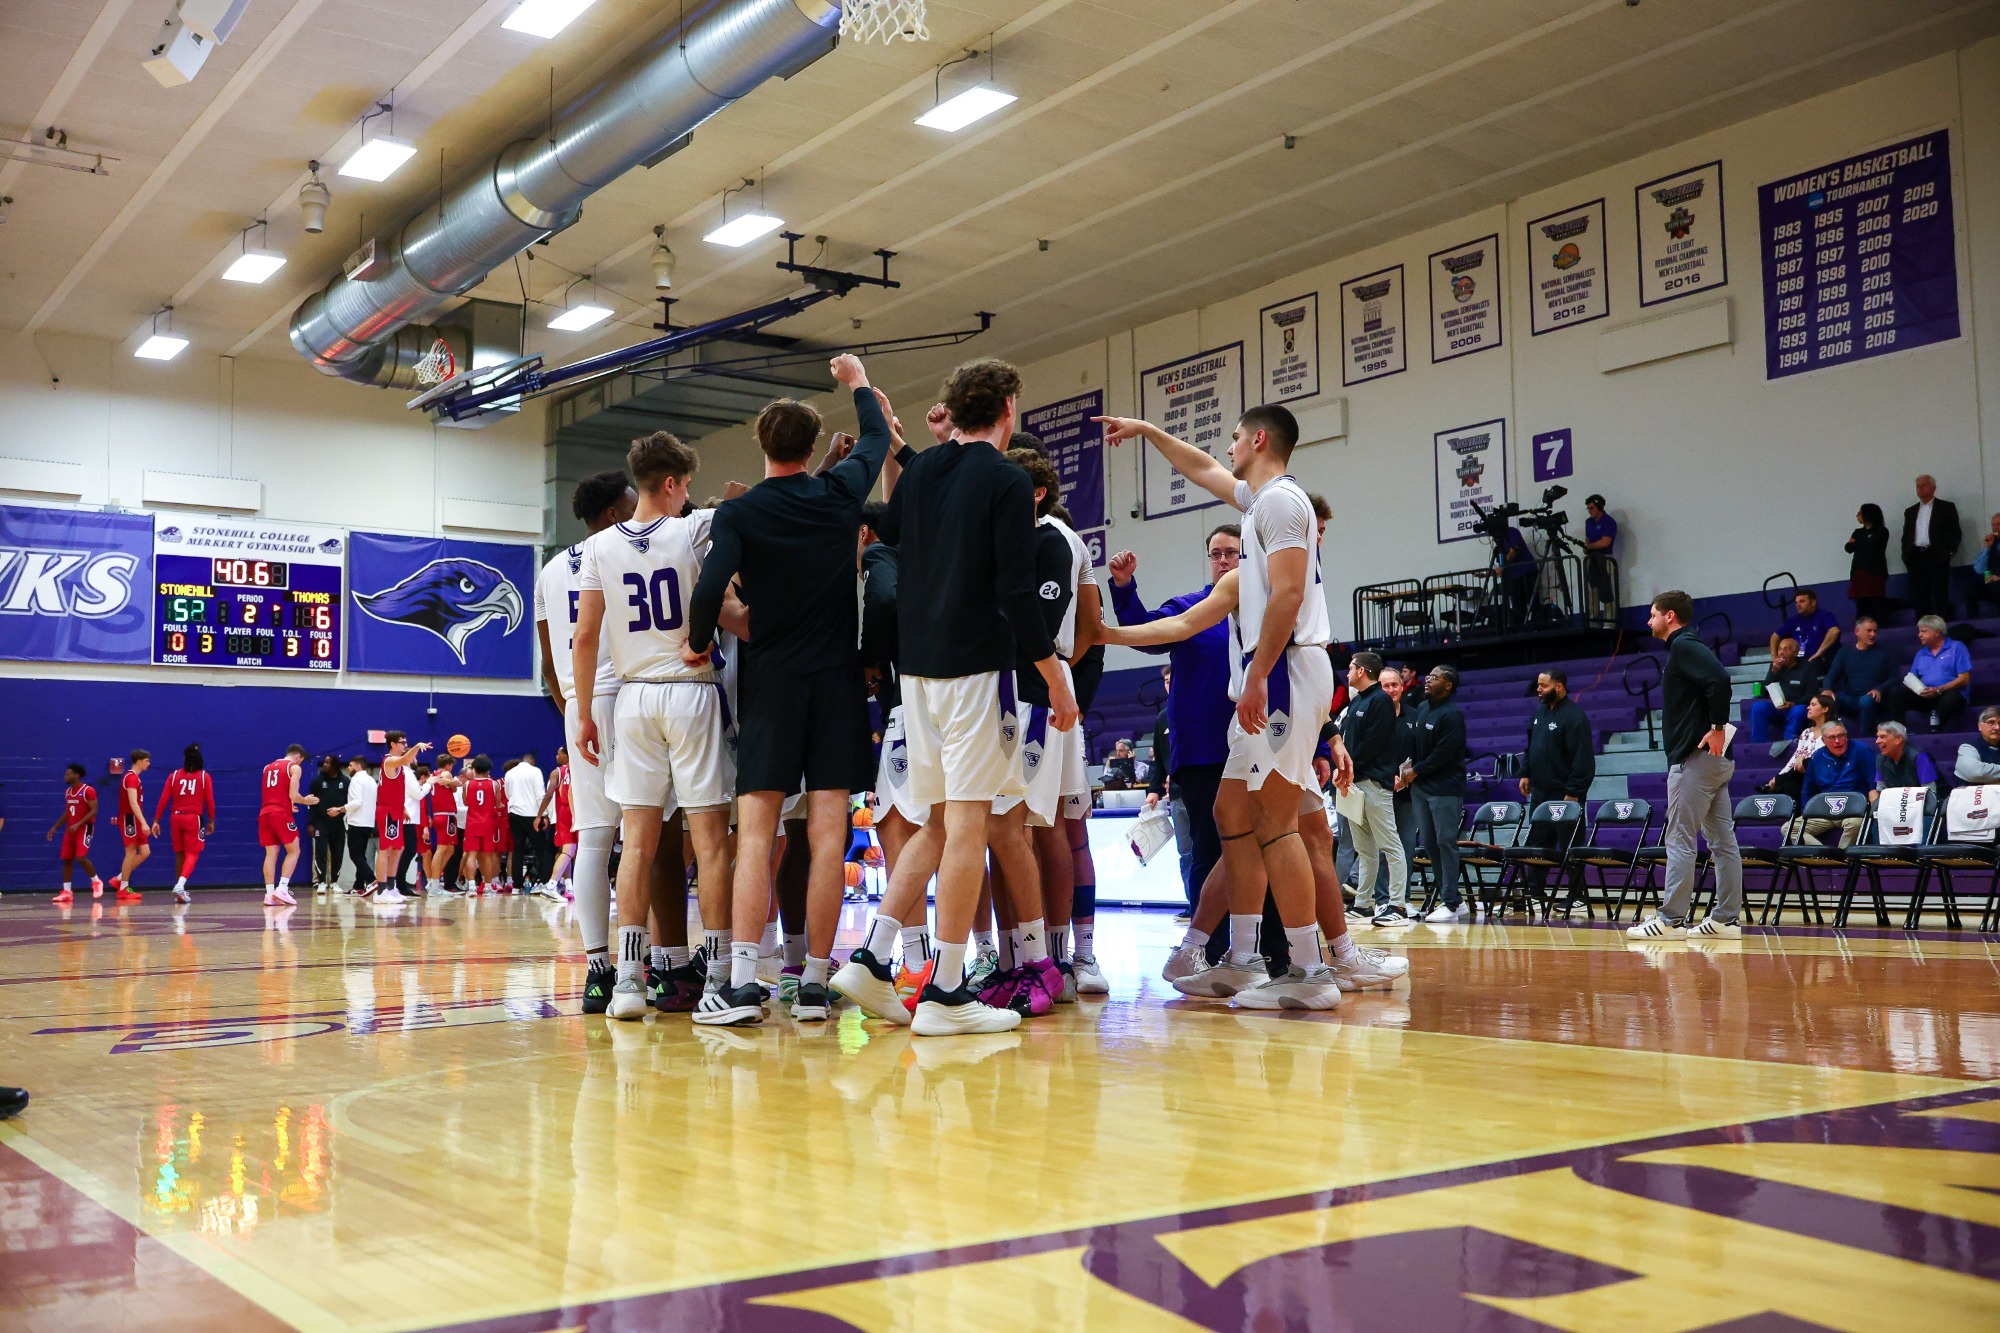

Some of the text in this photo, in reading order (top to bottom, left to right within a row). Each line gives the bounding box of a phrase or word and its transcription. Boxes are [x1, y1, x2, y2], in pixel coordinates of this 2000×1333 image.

[1774, 141, 1933, 203] WOMEN'S BASKETBALL
[1826, 172, 1895, 203] TOURNAMENT
[1904, 182, 1934, 203] 2019
[1857, 195, 1889, 217] 2007
[1903, 201, 1938, 223] 2020
[1814, 209, 1843, 229] 1995
[1857, 214, 1891, 236] 2008
[1774, 221, 1801, 240] 1983
[1815, 227, 1844, 247] 1996
[1775, 239, 1802, 258] 1985
[1858, 233, 1892, 255] 2009
[1655, 246, 1708, 268] REGIONAL CHAMPIONS
[1816, 246, 1844, 265] 1997
[1861, 253, 1890, 273] 2010
[1659, 258, 1705, 278] MEN'S BASKETBALL
[1776, 258, 1803, 276] 1987
[1817, 265, 1846, 284] 1998
[1664, 273, 1700, 290] 2016
[1777, 276, 1804, 295] 1988
[1862, 272, 1891, 292] 2013
[1818, 284, 1847, 303] 1999
[1863, 291, 1893, 310] 2014
[1553, 304, 1585, 320] 2012
[1779, 295, 1803, 313] 1991
[1817, 302, 1850, 322] 2003
[1778, 313, 1805, 331] 1992
[1864, 310, 1894, 330] 2015
[1779, 331, 1806, 350] 1993
[1818, 321, 1850, 341] 2004
[1865, 330, 1896, 350] 2018
[1451, 334, 1481, 349] 2006
[1819, 339, 1852, 359] 2006
[1362, 360, 1387, 372] 1995
[1780, 350, 1808, 368] 1994
[1157, 356, 1226, 386] MEN'S BASKETBALL
[1186, 373, 1217, 389] CHAMPIONS
[1279, 383, 1302, 395] 1994
[1540, 439, 1564, 470] 7
[192, 527, 256, 539] STONEHILL
[260, 532, 311, 543] COLLEGE
[186, 538, 243, 549] MERKERT
[247, 542, 316, 554] GYMNASIUM
[1087, 538, 1101, 560] 6
[216, 560, 269, 585] 40.6
[0, 547, 139, 619] KS
[160, 583, 214, 597] STONEHILL
[1042, 585, 1058, 598] 24
[237, 594, 263, 603] PERIOD
[292, 591, 330, 603] THOMAS
[623, 567, 683, 632] 30
[243, 604, 256, 623] 2
[163, 624, 187, 632] FOULS
[196, 625, 217, 633] T.O.L.
[224, 627, 274, 636] PLAYER FOUL
[310, 631, 332, 639] FOULS
[172, 632, 184, 652] 0
[202, 634, 213, 652] 3
[287, 638, 298, 656] 3
[318, 640, 329, 657] 0
[163, 654, 187, 662] SCORE
[237, 657, 262, 665] MATCH
[309, 660, 332, 668] SCORE
[180, 779, 196, 795] 24
[267, 770, 279, 788] 13
[476, 790, 484, 805] 9
